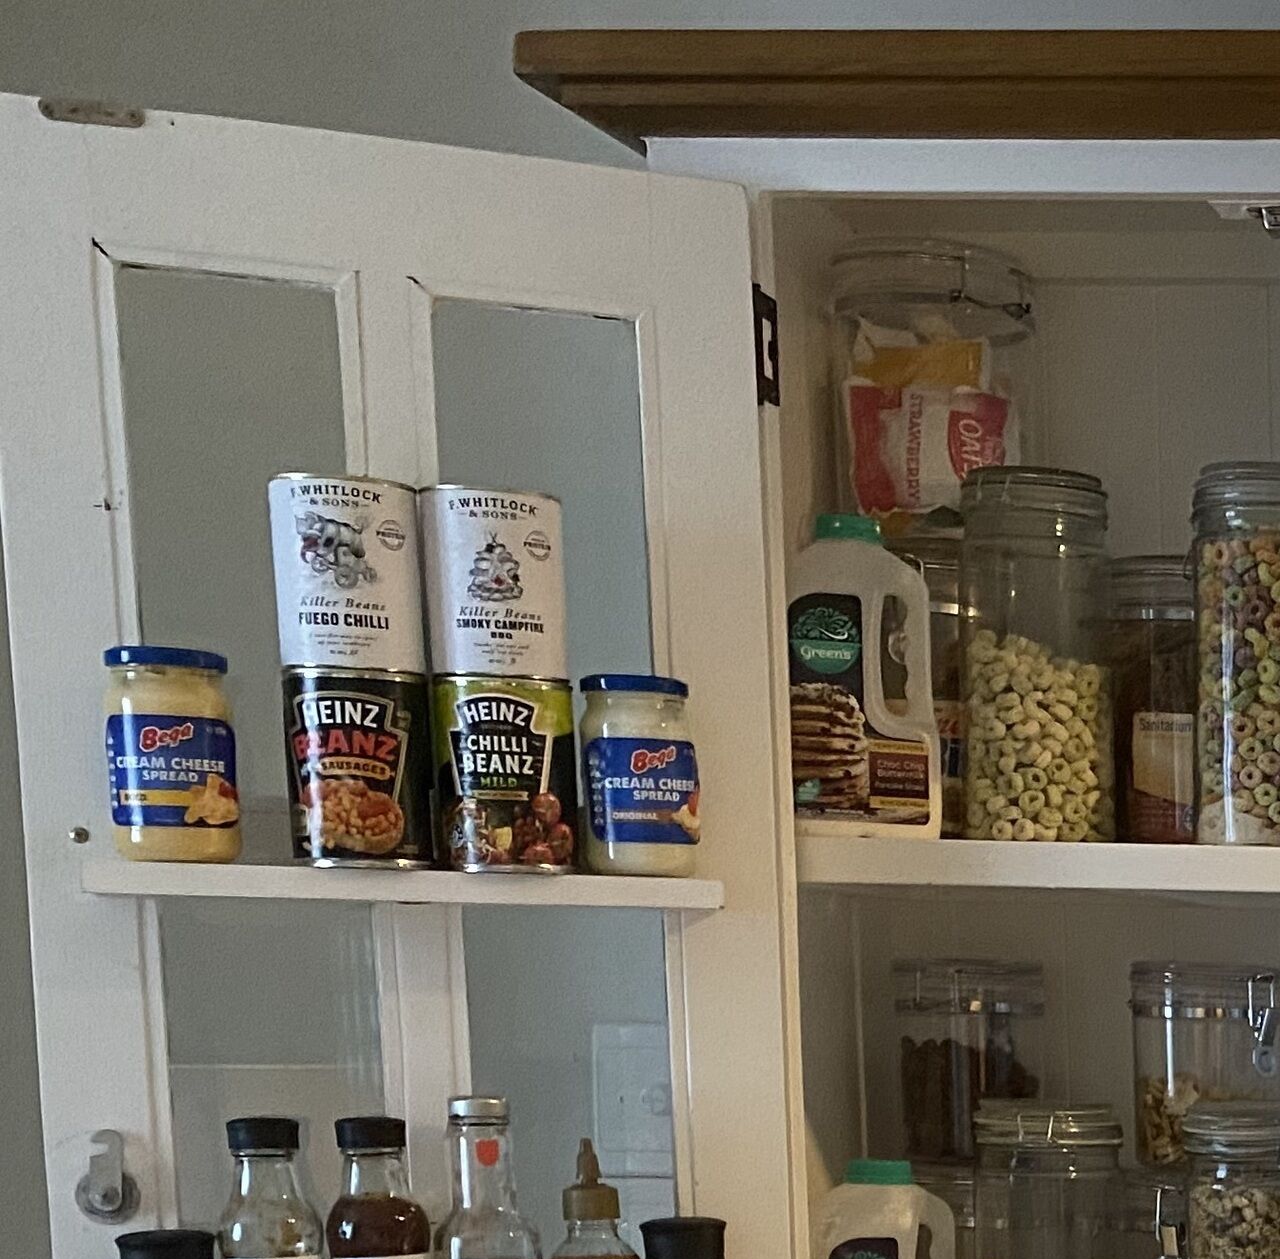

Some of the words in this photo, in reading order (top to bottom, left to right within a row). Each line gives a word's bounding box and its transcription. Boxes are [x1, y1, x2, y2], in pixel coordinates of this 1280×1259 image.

[322, 499, 359, 508] SONS
[469, 510, 478, 518] &
[482, 511, 517, 520] SONS
[301, 596, 339, 607] Killer
[345, 598, 386, 611] Beans
[299, 612, 339, 626] FUEGO
[344, 614, 389, 630] CHILLI
[459, 606, 498, 617] Killer
[504, 608, 542, 621] Beans
[457, 619, 491, 629] SMOKY
[494, 619, 544, 633] CAMPFIRE
[801, 647, 850, 660] Green's
[302, 701, 380, 728] HEINZ
[465, 702, 529, 726] HEINZ
[140, 722, 194, 752] Bega
[295, 729, 398, 760] BEANZ
[467, 735, 527, 752] CHILLI
[116, 756, 166, 768] CREAM
[171, 758, 225, 772] CHEESE
[320, 760, 386, 775] SAUSAGES
[463, 753, 535, 775] BEANZ
[630, 746, 676, 774] Bega
[143, 770, 198, 782] SPREAD
[481, 777, 518, 788] MILD
[605, 777, 654, 789] CREAM
[633, 791, 680, 801] SPREAD
